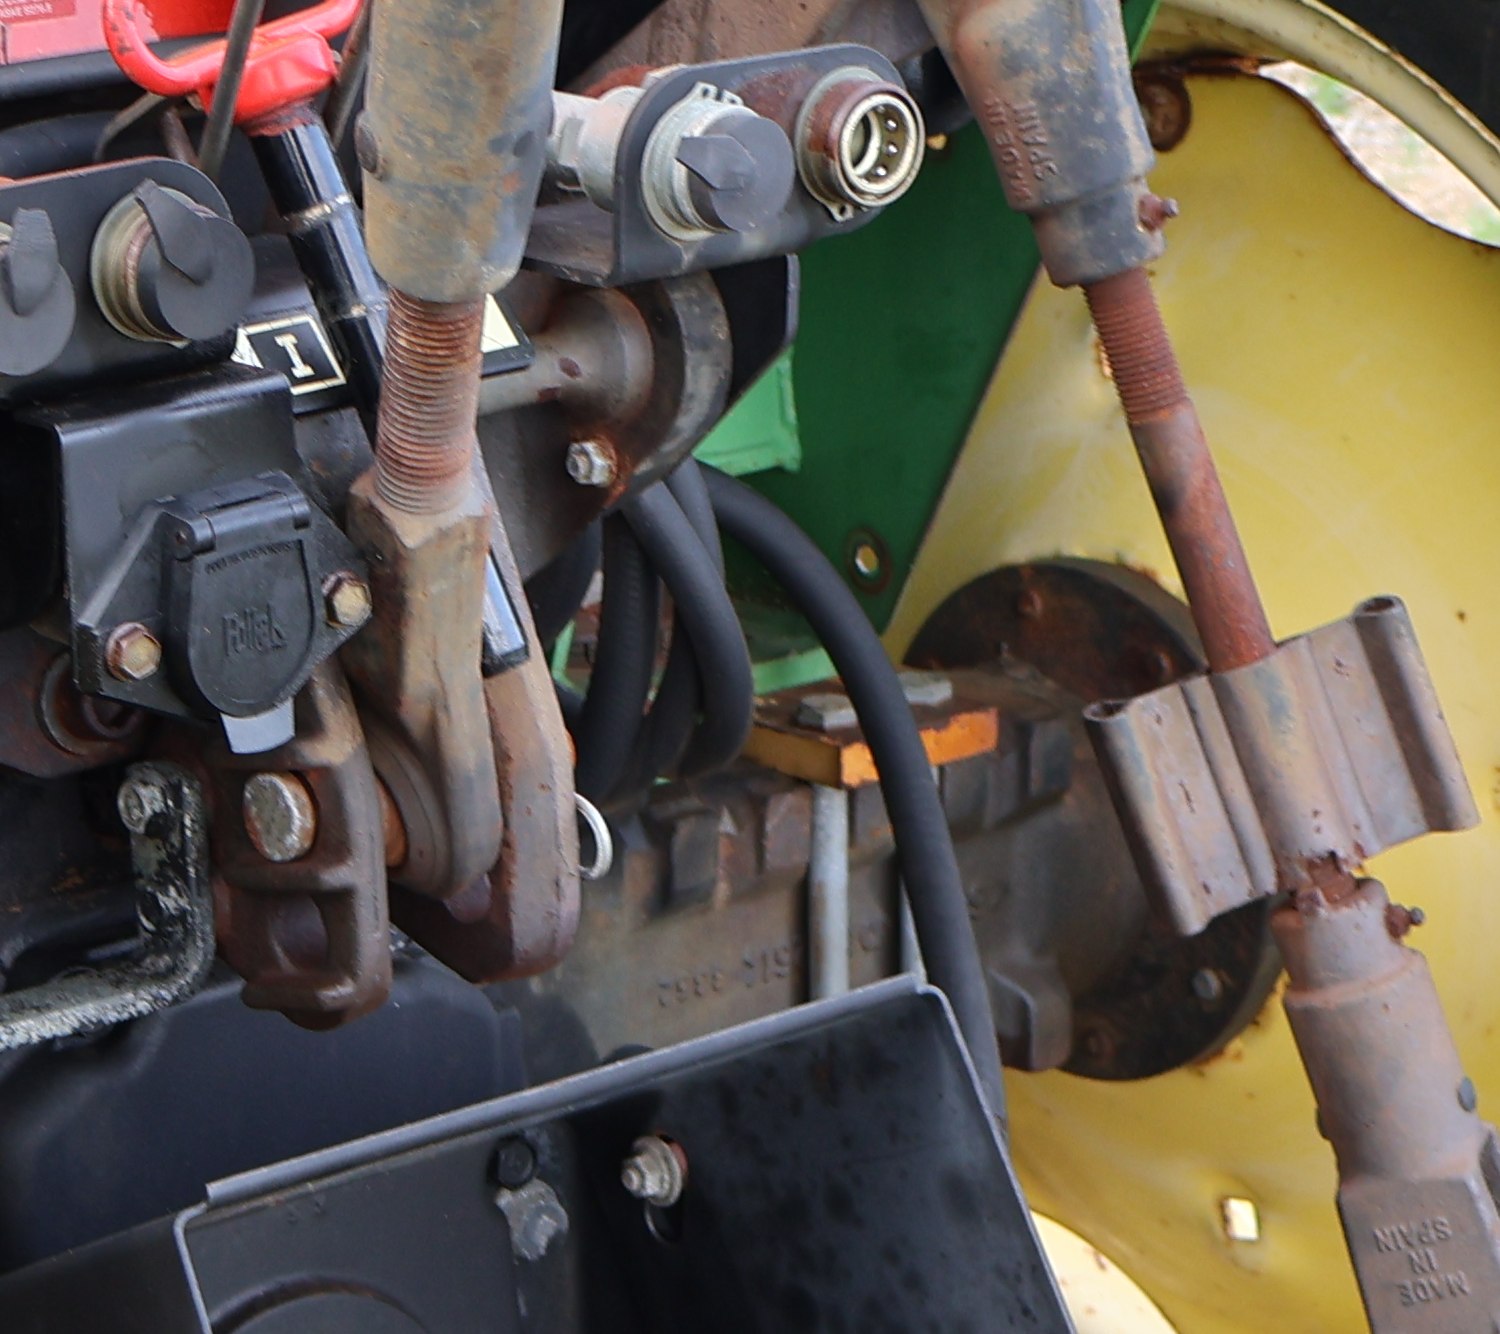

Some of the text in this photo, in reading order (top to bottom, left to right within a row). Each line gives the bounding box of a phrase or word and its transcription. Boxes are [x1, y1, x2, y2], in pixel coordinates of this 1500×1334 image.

[1372, 1215, 1454, 1254] SPAIN
[1407, 1247, 1439, 1275] IN
[1398, 1269, 1472, 1308] MADE
